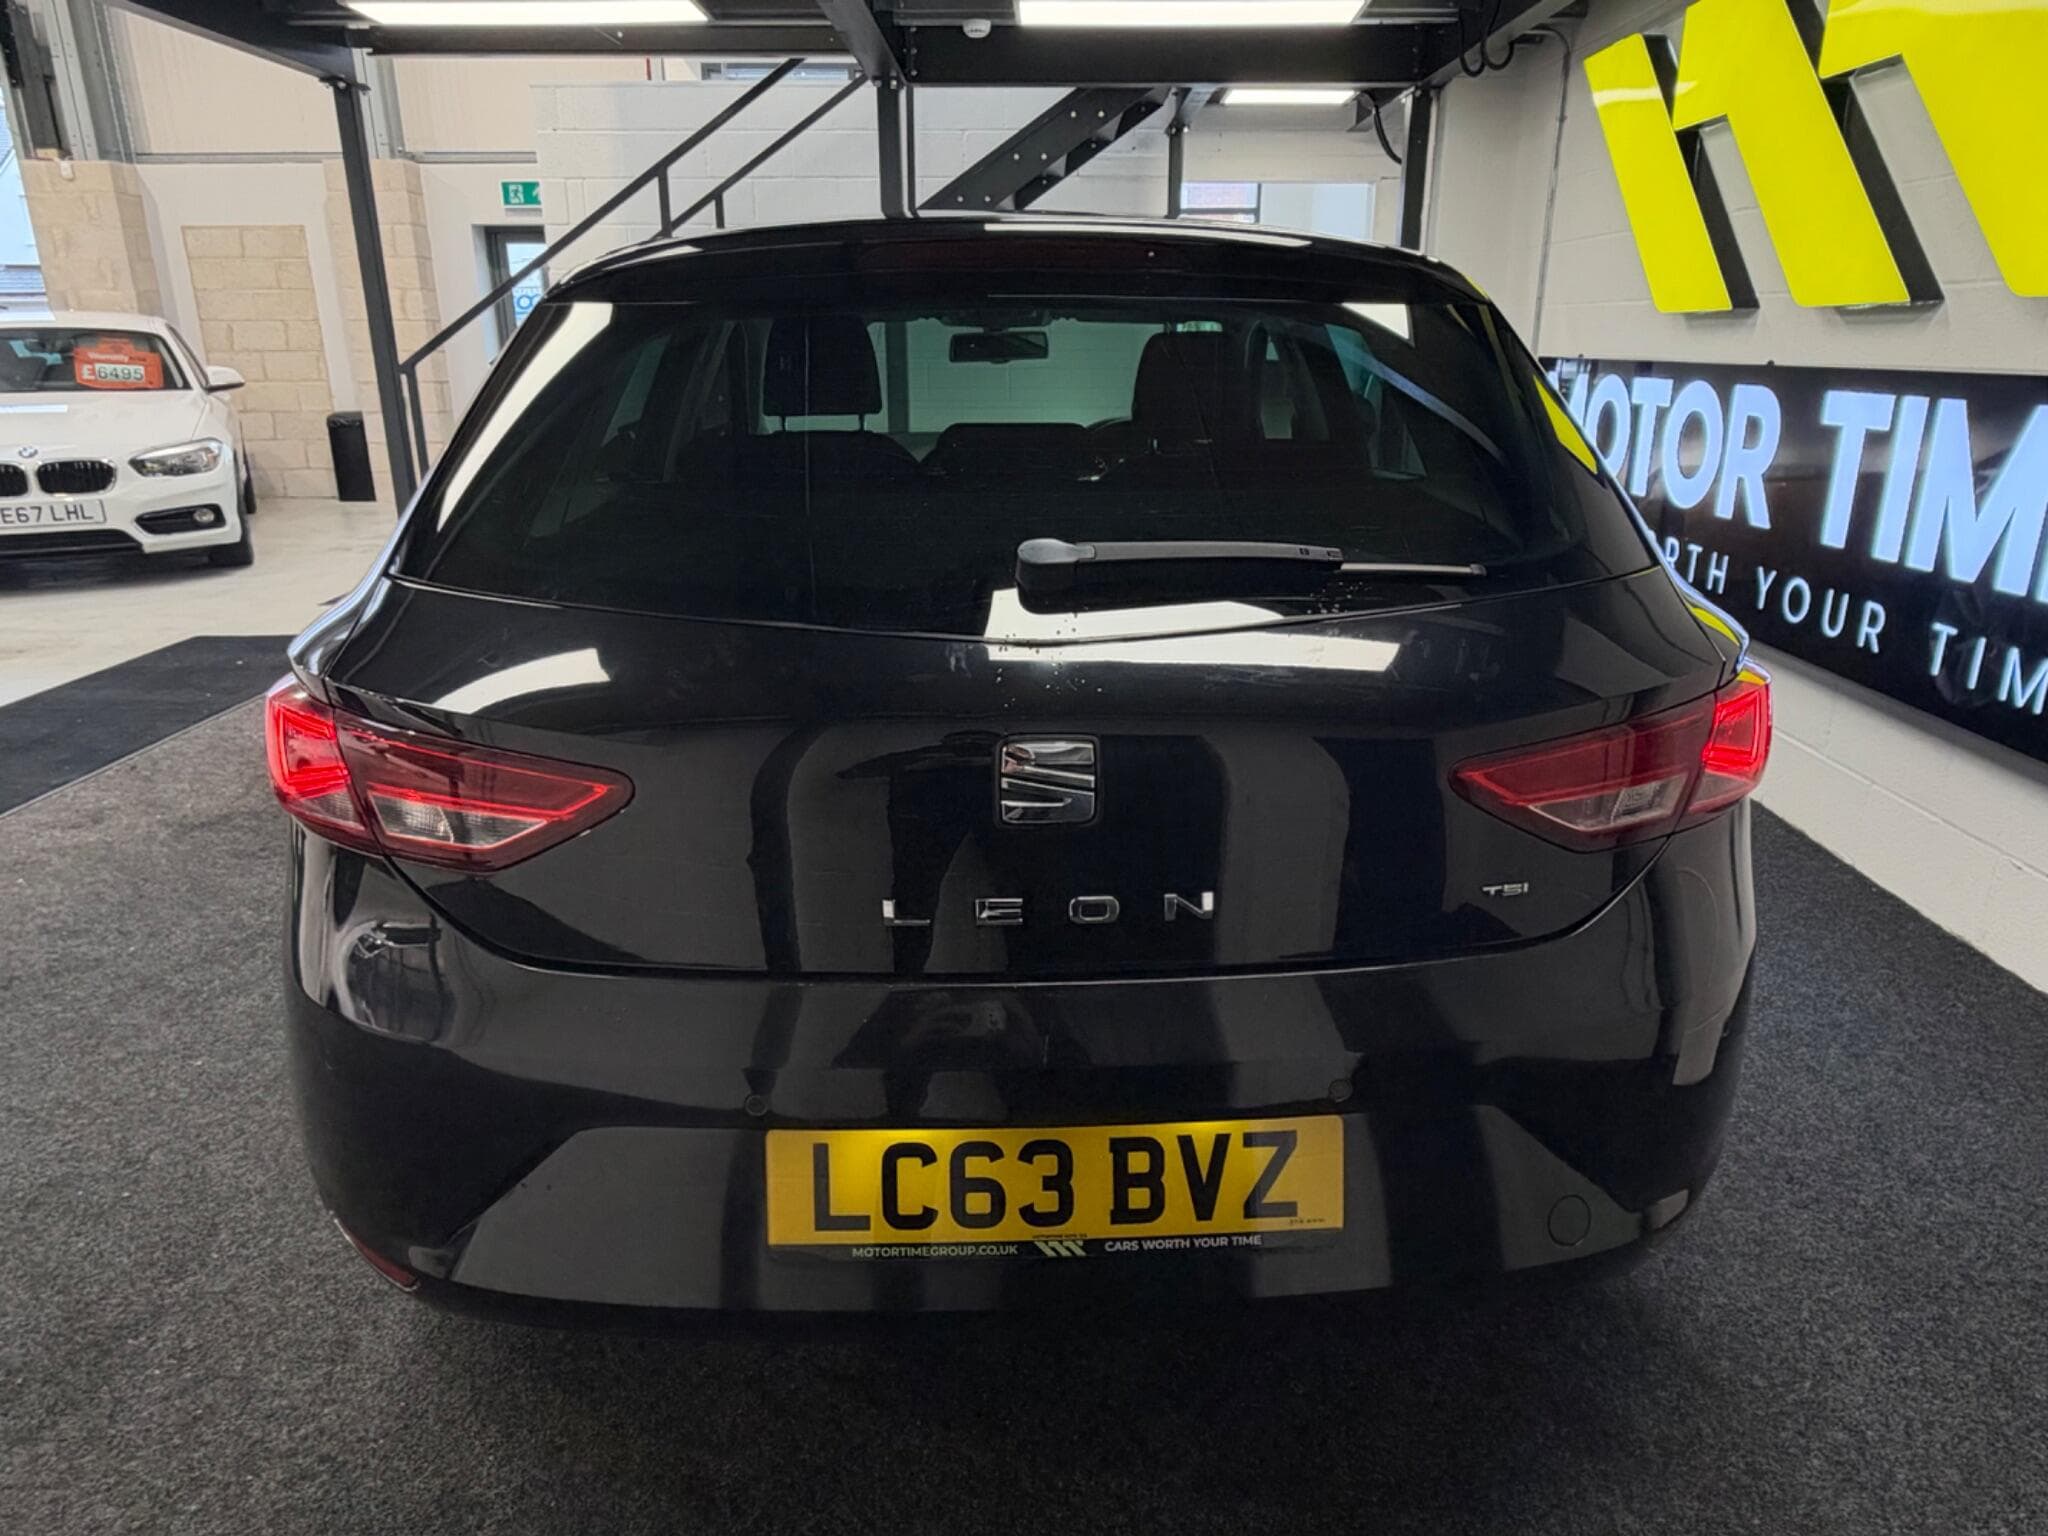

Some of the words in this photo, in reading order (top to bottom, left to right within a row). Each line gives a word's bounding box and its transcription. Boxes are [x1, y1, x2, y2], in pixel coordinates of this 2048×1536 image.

[49, 503, 94, 521] LHL
[1820, 390, 2048, 604] TIM
[1649, 529, 1729, 595] RTH
[1755, 566, 1886, 654] YOUR
[1930, 621, 2048, 715] TIM
[882, 891, 1214, 926] LEON
[812, 1139, 1074, 1231] LC63
[1109, 1132, 1298, 1225] BVZ
[852, 1244, 1018, 1258] MOTORTIMEGROUP.CO.UK
[1104, 1240, 1140, 1252] CARS
[1142, 1238, 1190, 1250] WORTH
[1193, 1236, 1229, 1248] YOUR
[1232, 1234, 1262, 1246] TIME
